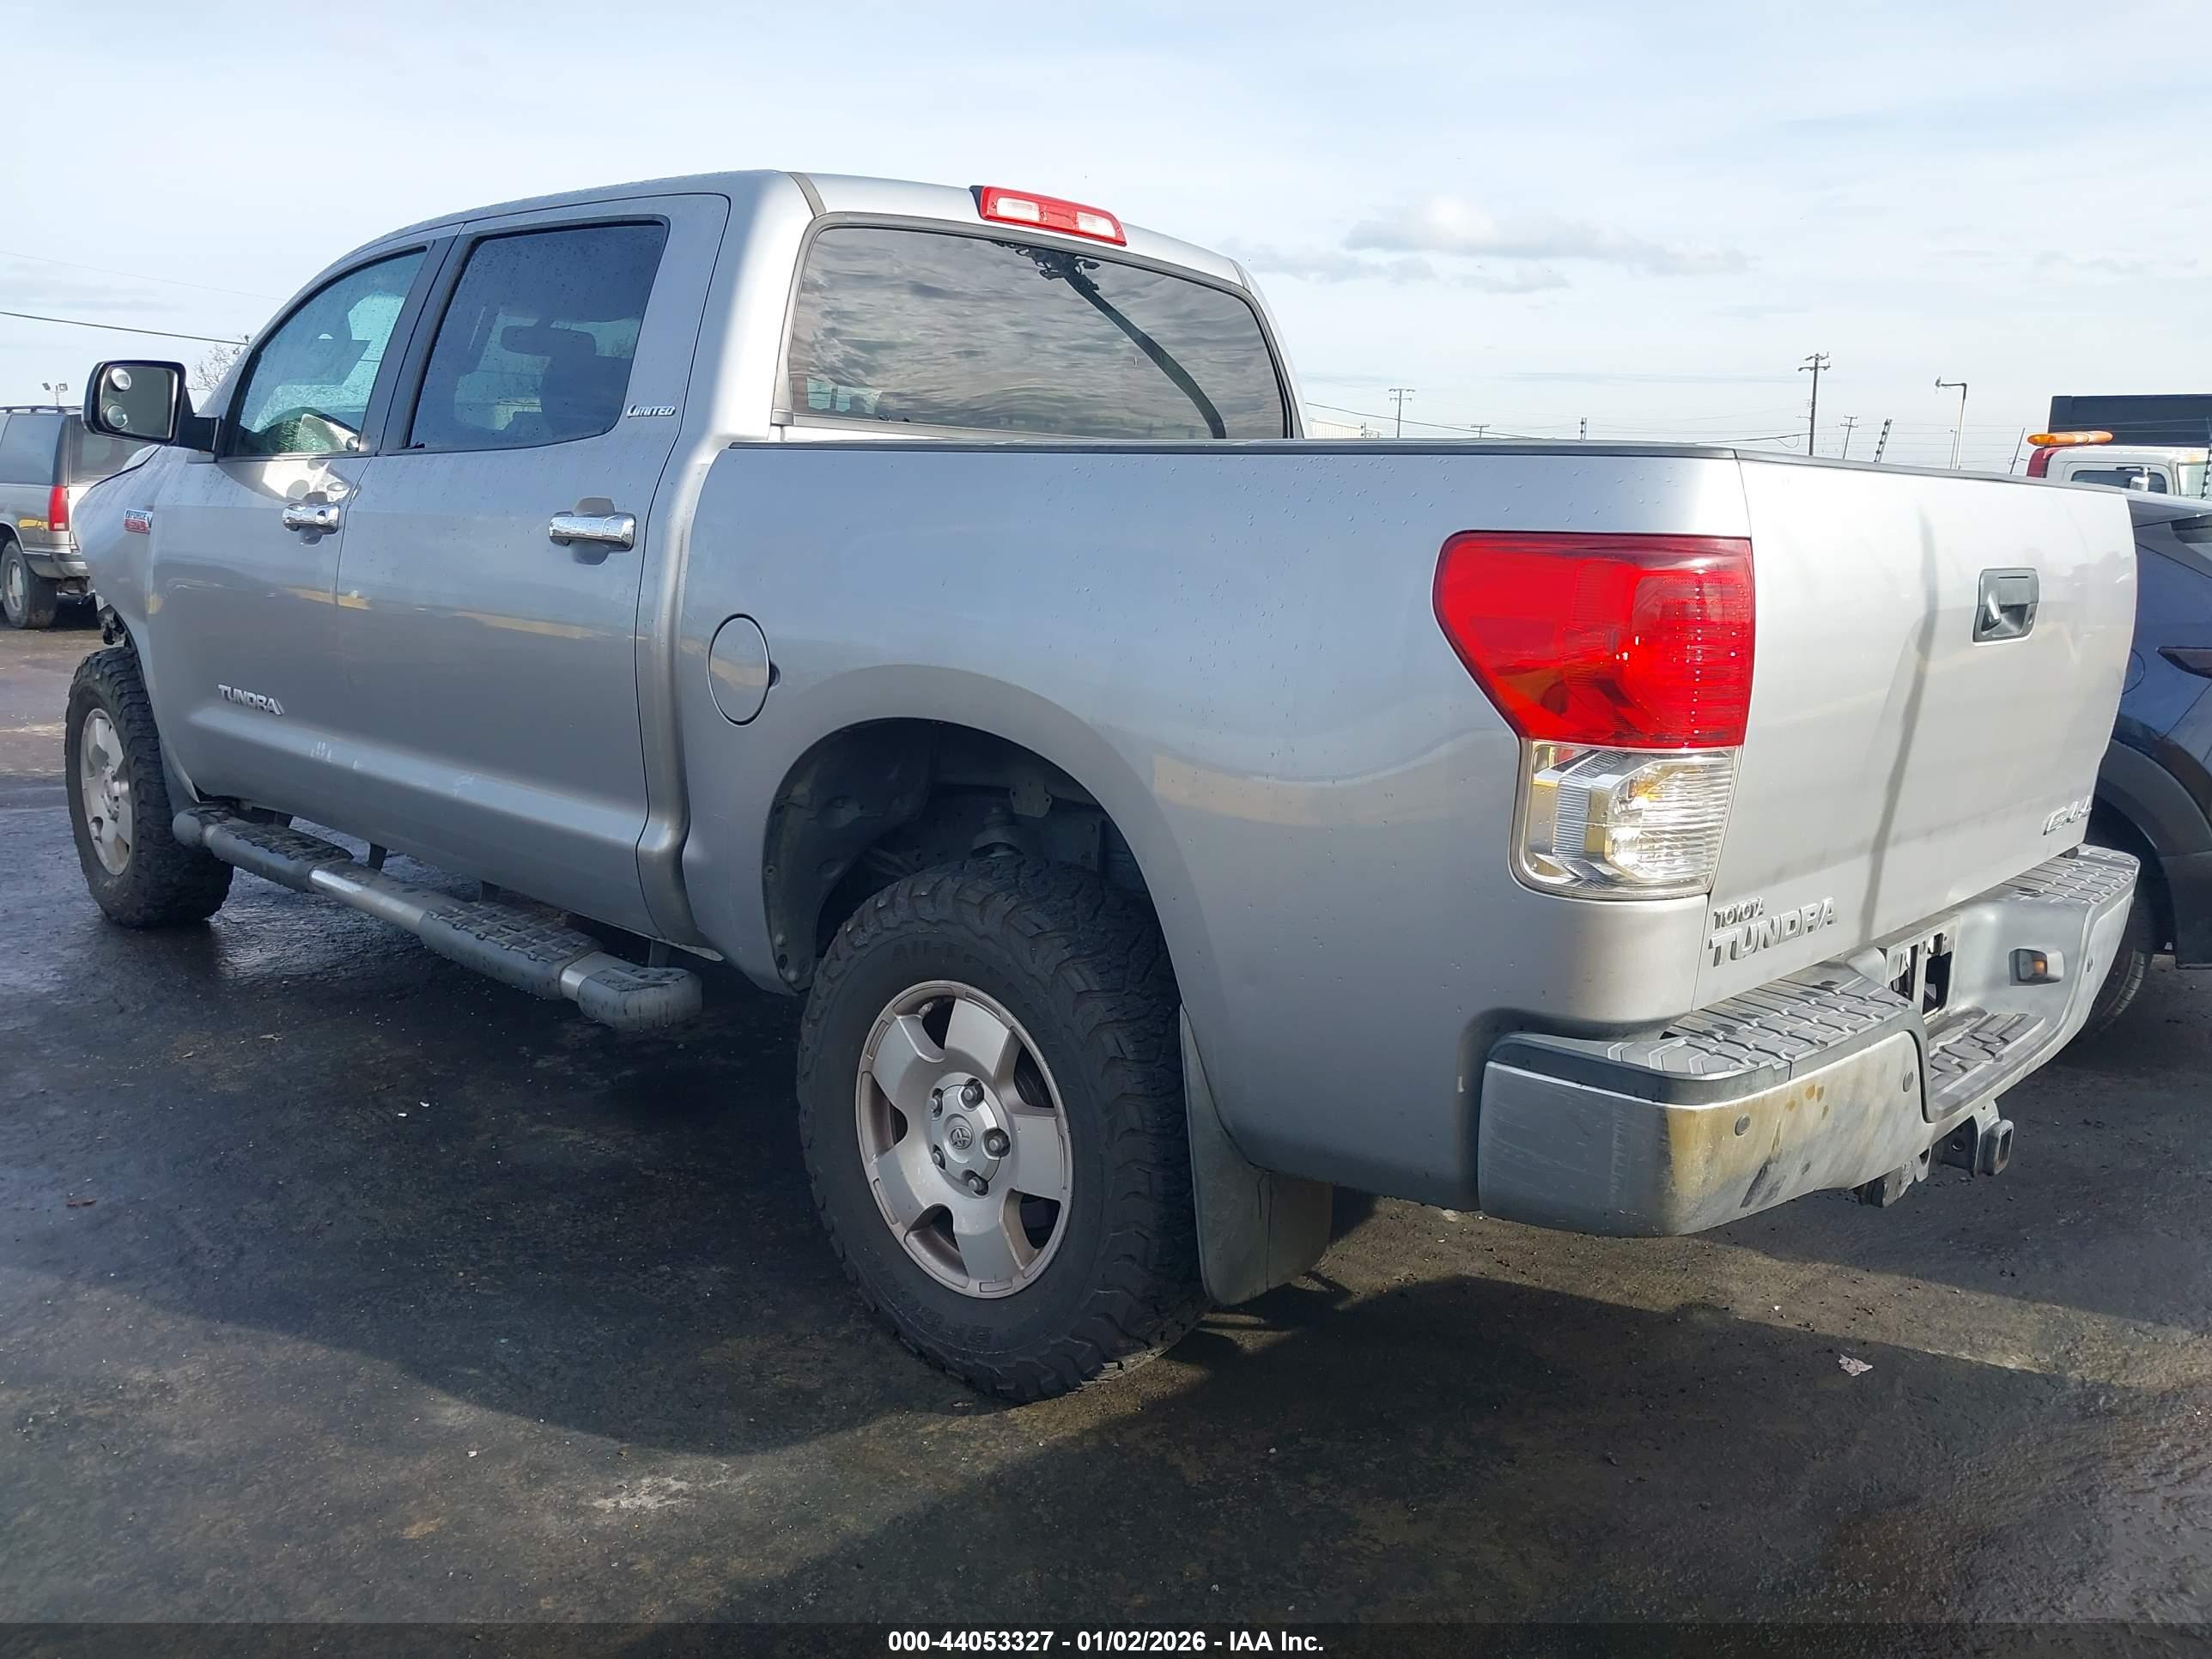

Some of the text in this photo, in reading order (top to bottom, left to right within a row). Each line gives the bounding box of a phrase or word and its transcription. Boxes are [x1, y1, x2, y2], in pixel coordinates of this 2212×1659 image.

[217, 684, 284, 715] TUNDRA
[1713, 896, 1765, 931] TOYOTA
[1708, 896, 1837, 968] TUNDRA
